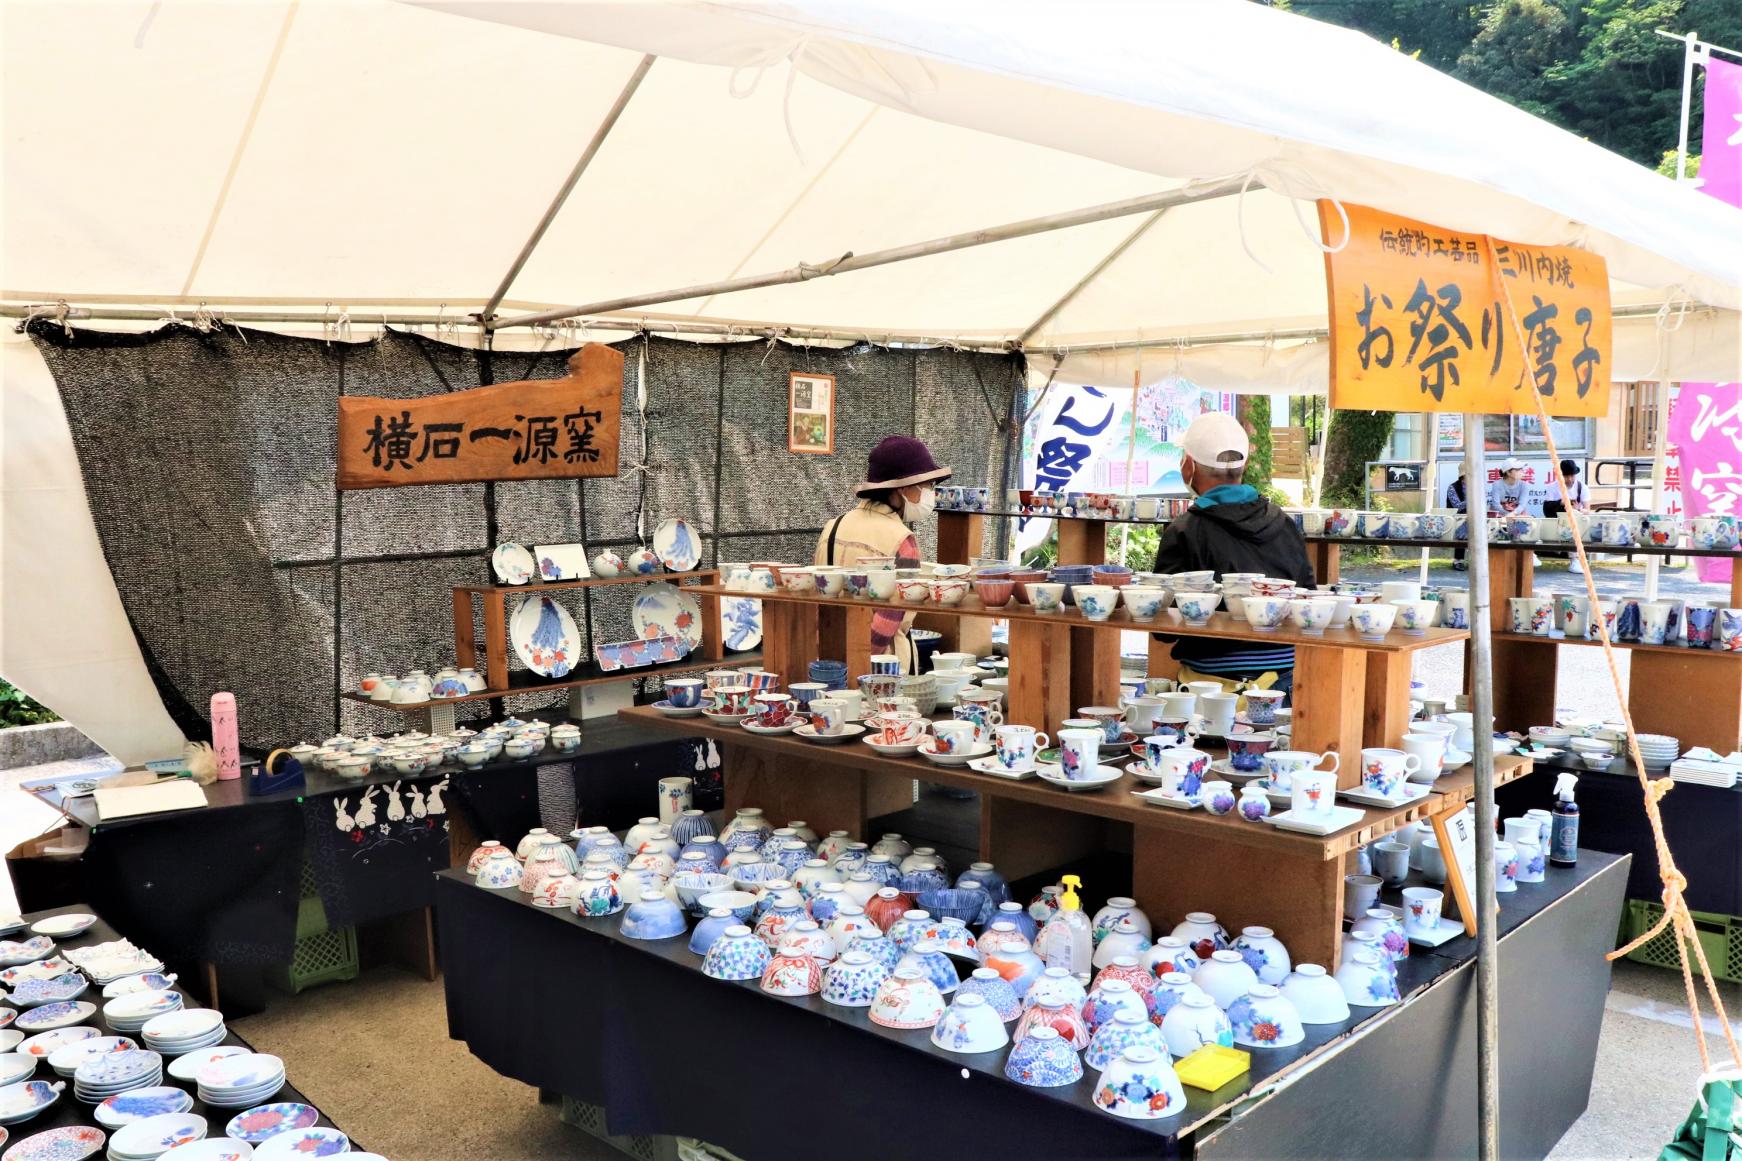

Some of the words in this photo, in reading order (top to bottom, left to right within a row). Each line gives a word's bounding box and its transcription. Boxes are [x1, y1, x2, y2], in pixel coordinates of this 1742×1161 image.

[1496, 245, 1575, 290] 三川内焼
[1355, 277, 1601, 402] お祭り唐子
[363, 405, 602, 472] 横石一源窯
